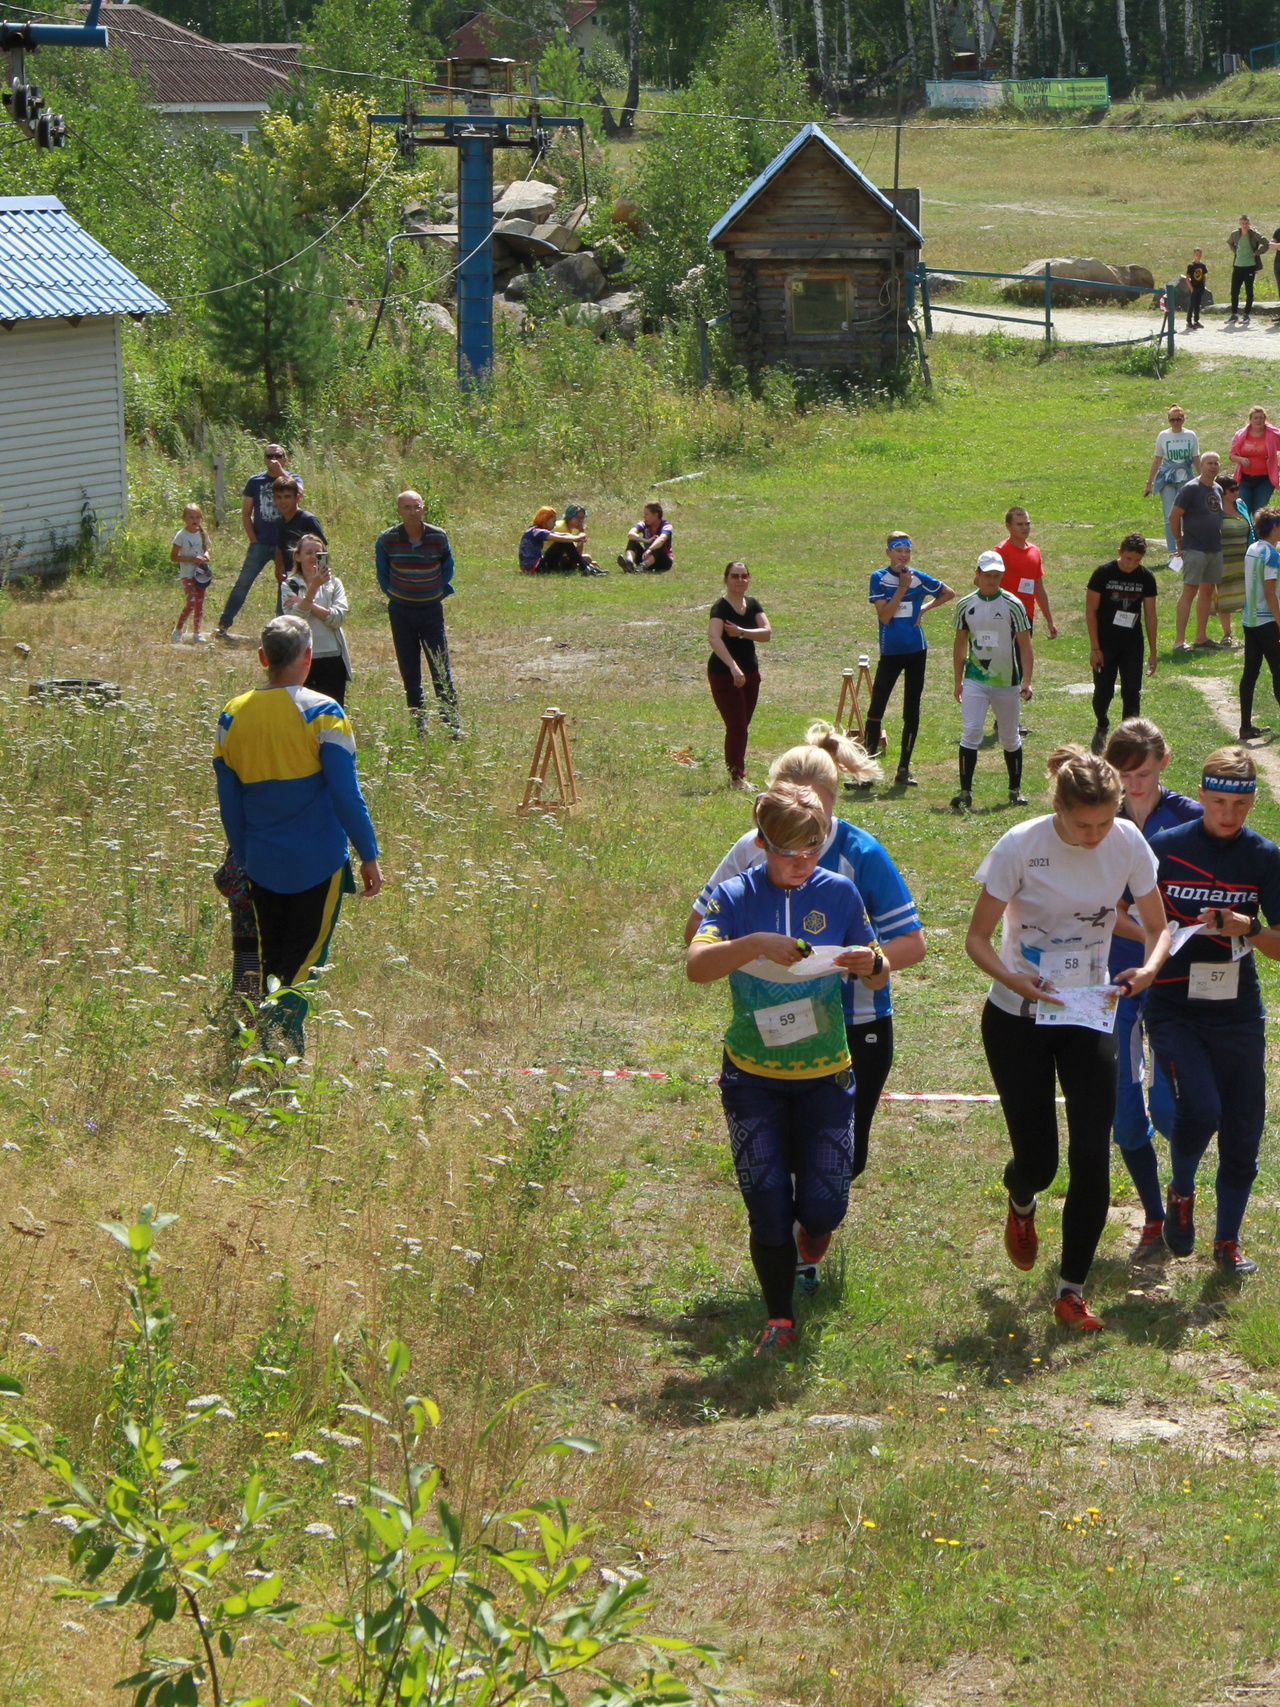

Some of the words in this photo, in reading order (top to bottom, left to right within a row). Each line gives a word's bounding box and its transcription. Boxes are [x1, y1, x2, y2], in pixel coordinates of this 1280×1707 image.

[1016, 81, 1052, 94] МИНСПОРТ
[1023, 95, 1048, 107] РОССИИ
[1028, 858, 1051, 868] 2021
[1166, 884, 1259, 903] noname
[1064, 958, 1079, 969] 58
[1210, 971, 1226, 982] 57
[779, 1012, 796, 1026] 59
